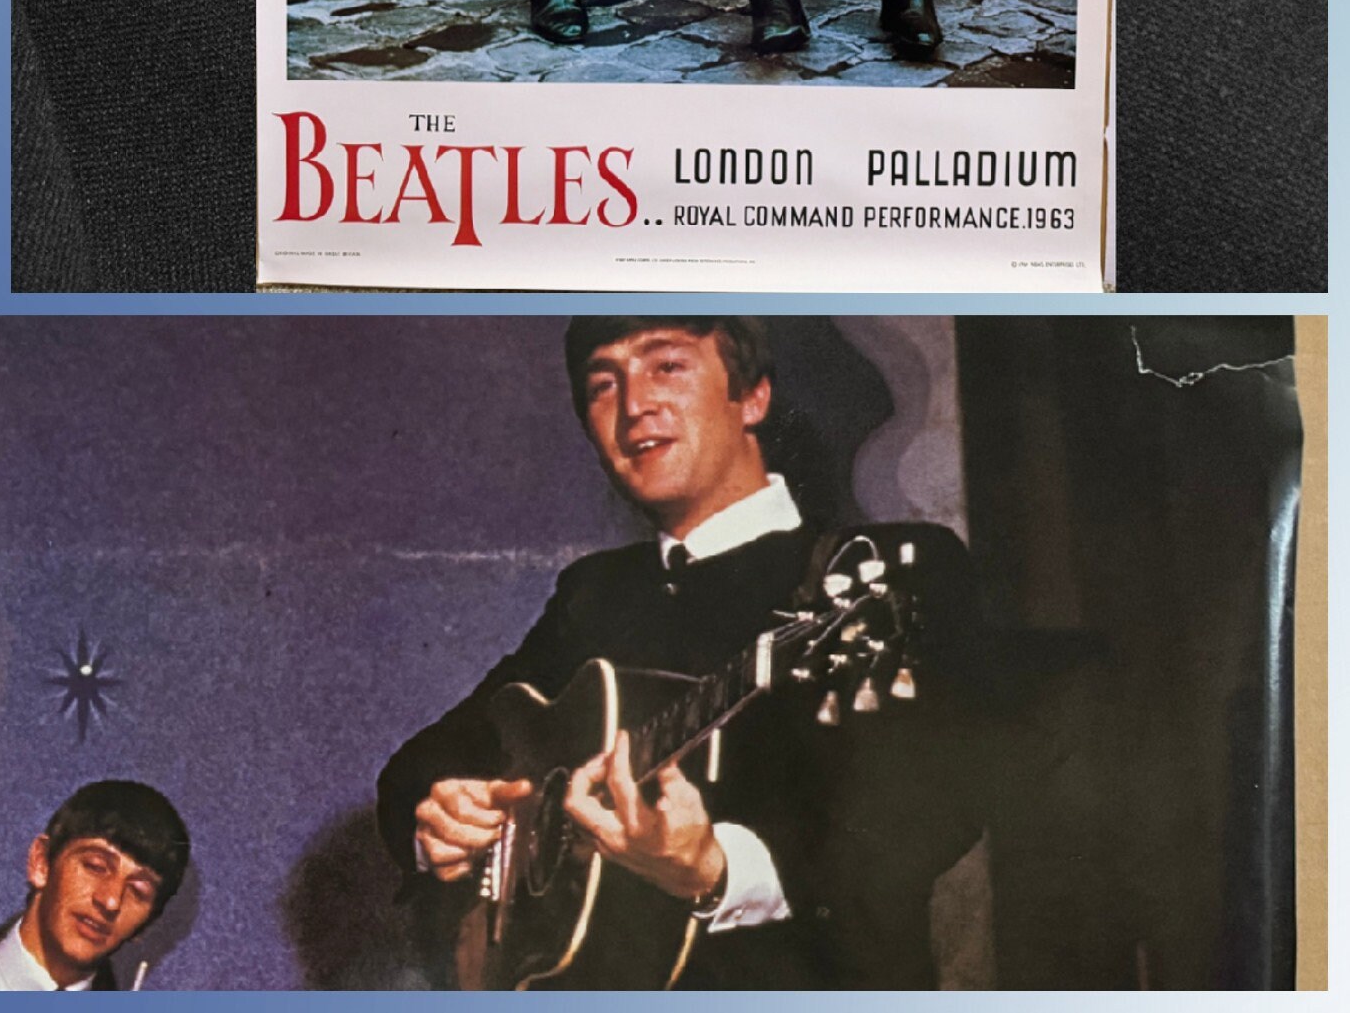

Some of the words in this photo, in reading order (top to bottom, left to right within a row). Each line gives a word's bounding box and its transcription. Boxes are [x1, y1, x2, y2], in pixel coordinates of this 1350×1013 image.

[408, 114, 456, 133] THE
[675, 148, 813, 185] LONDON
[867, 150, 1077, 187] PALLADIUM
[674, 205, 737, 226] ROYAL
[744, 206, 853, 228] COMMAND
